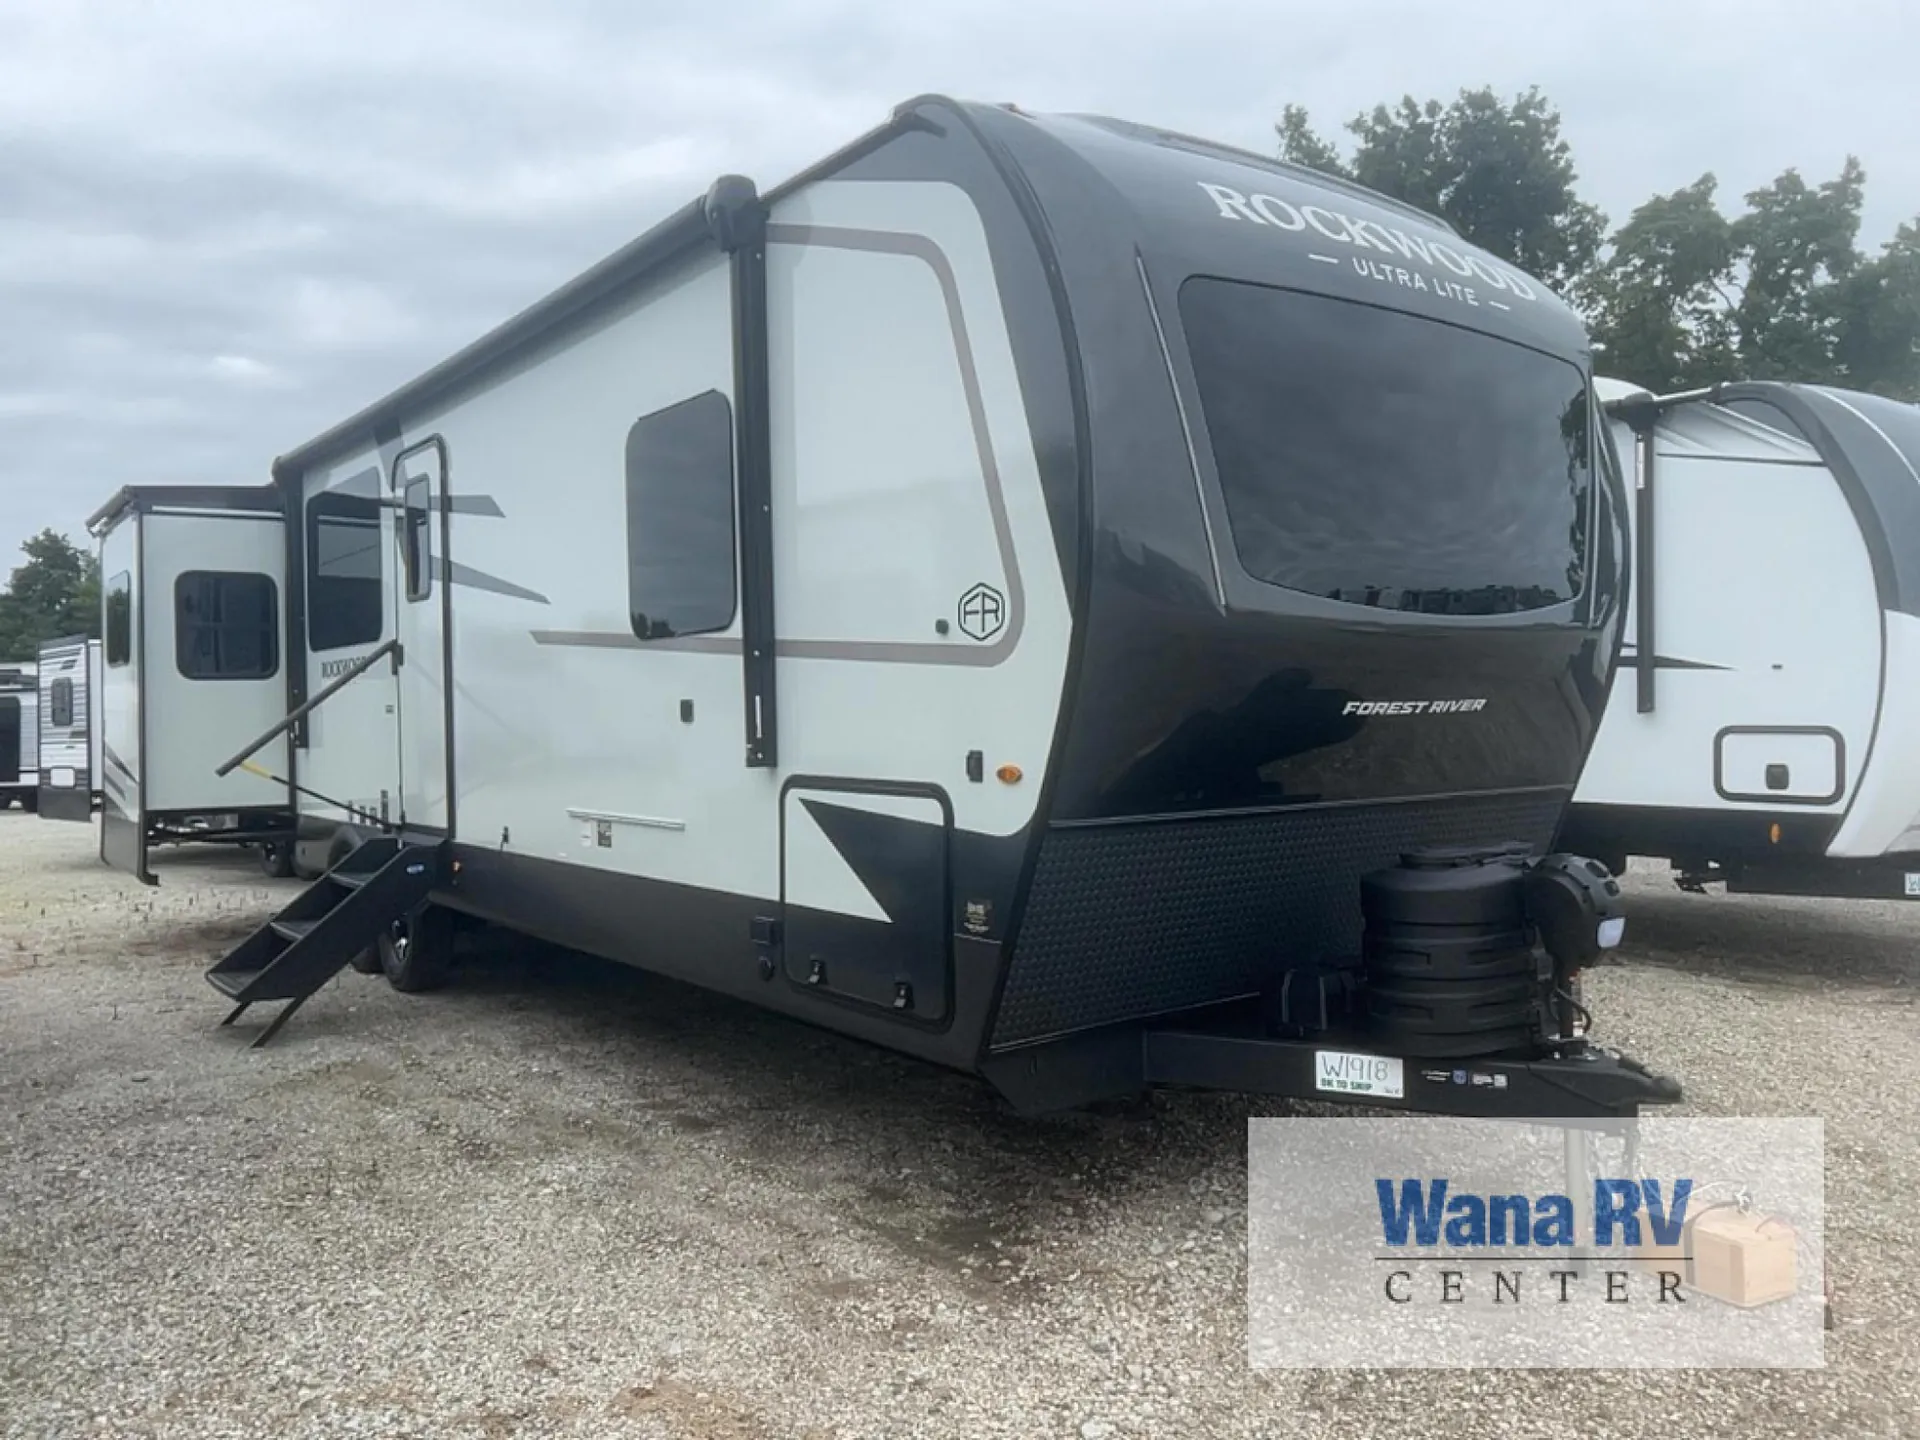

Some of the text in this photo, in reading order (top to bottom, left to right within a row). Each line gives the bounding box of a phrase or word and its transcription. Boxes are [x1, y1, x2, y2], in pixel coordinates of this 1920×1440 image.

[1197, 180, 1537, 301] ROCKWOOD
[1352, 256, 1480, 307] ULTRA LITE
[1342, 698, 1488, 716] FOREST RIVER
[1321, 1054, 1389, 1082] W1918
